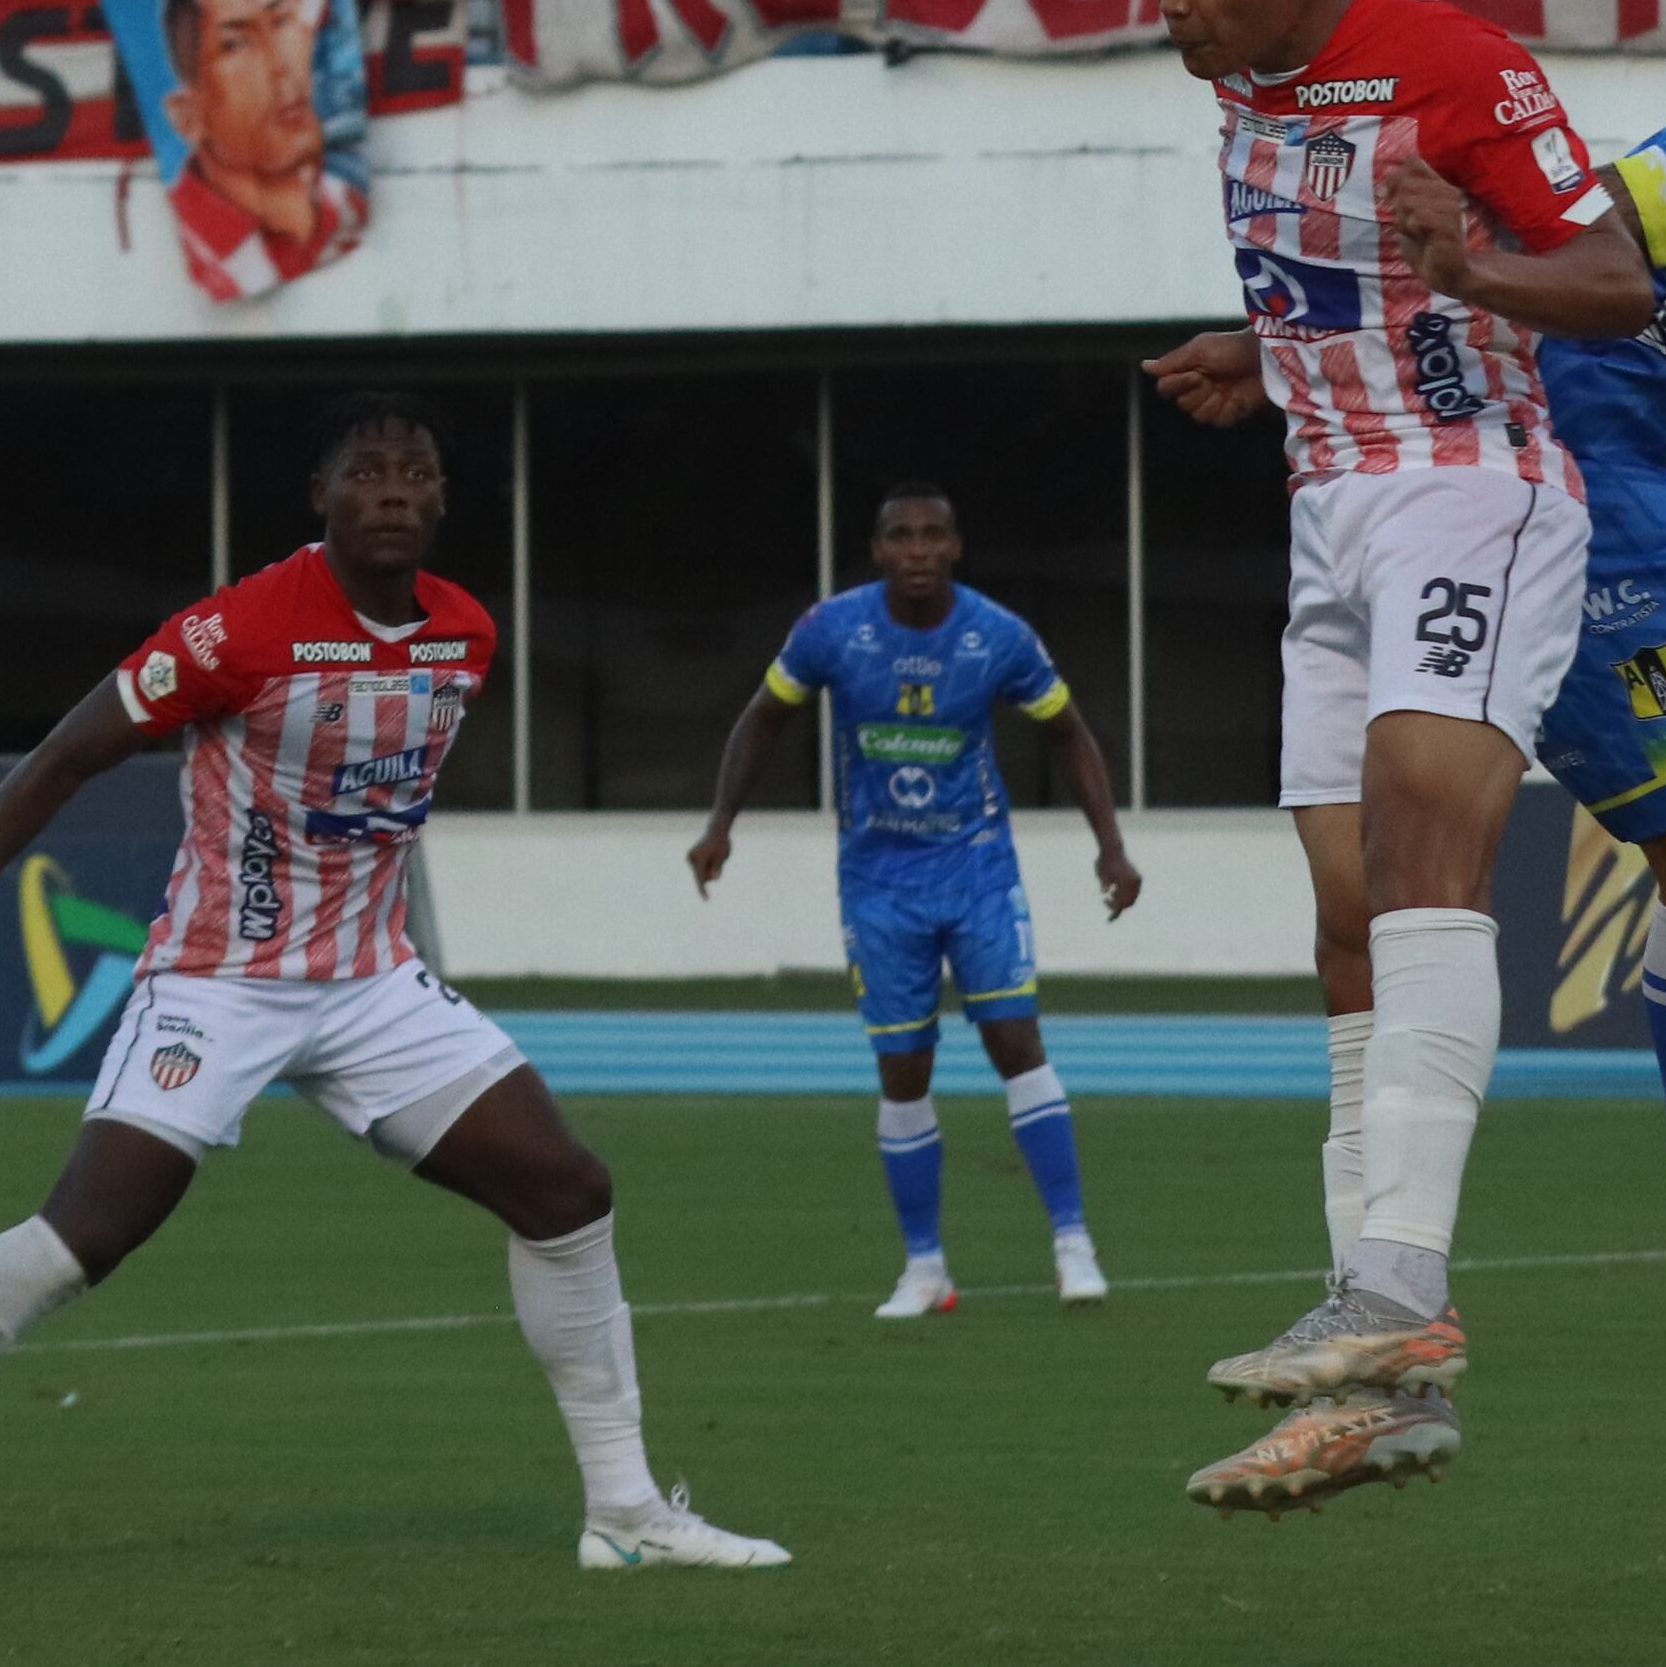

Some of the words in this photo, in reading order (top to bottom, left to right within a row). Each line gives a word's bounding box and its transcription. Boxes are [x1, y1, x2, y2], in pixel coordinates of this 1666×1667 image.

[1294, 78, 1395, 109] POSTOBON
[1415, 575, 1492, 655] 25
[1589, 599, 1661, 635] CONTRATISTA
[293, 641, 372, 663] POSTOBON
[409, 640, 467, 663] POSTOBON
